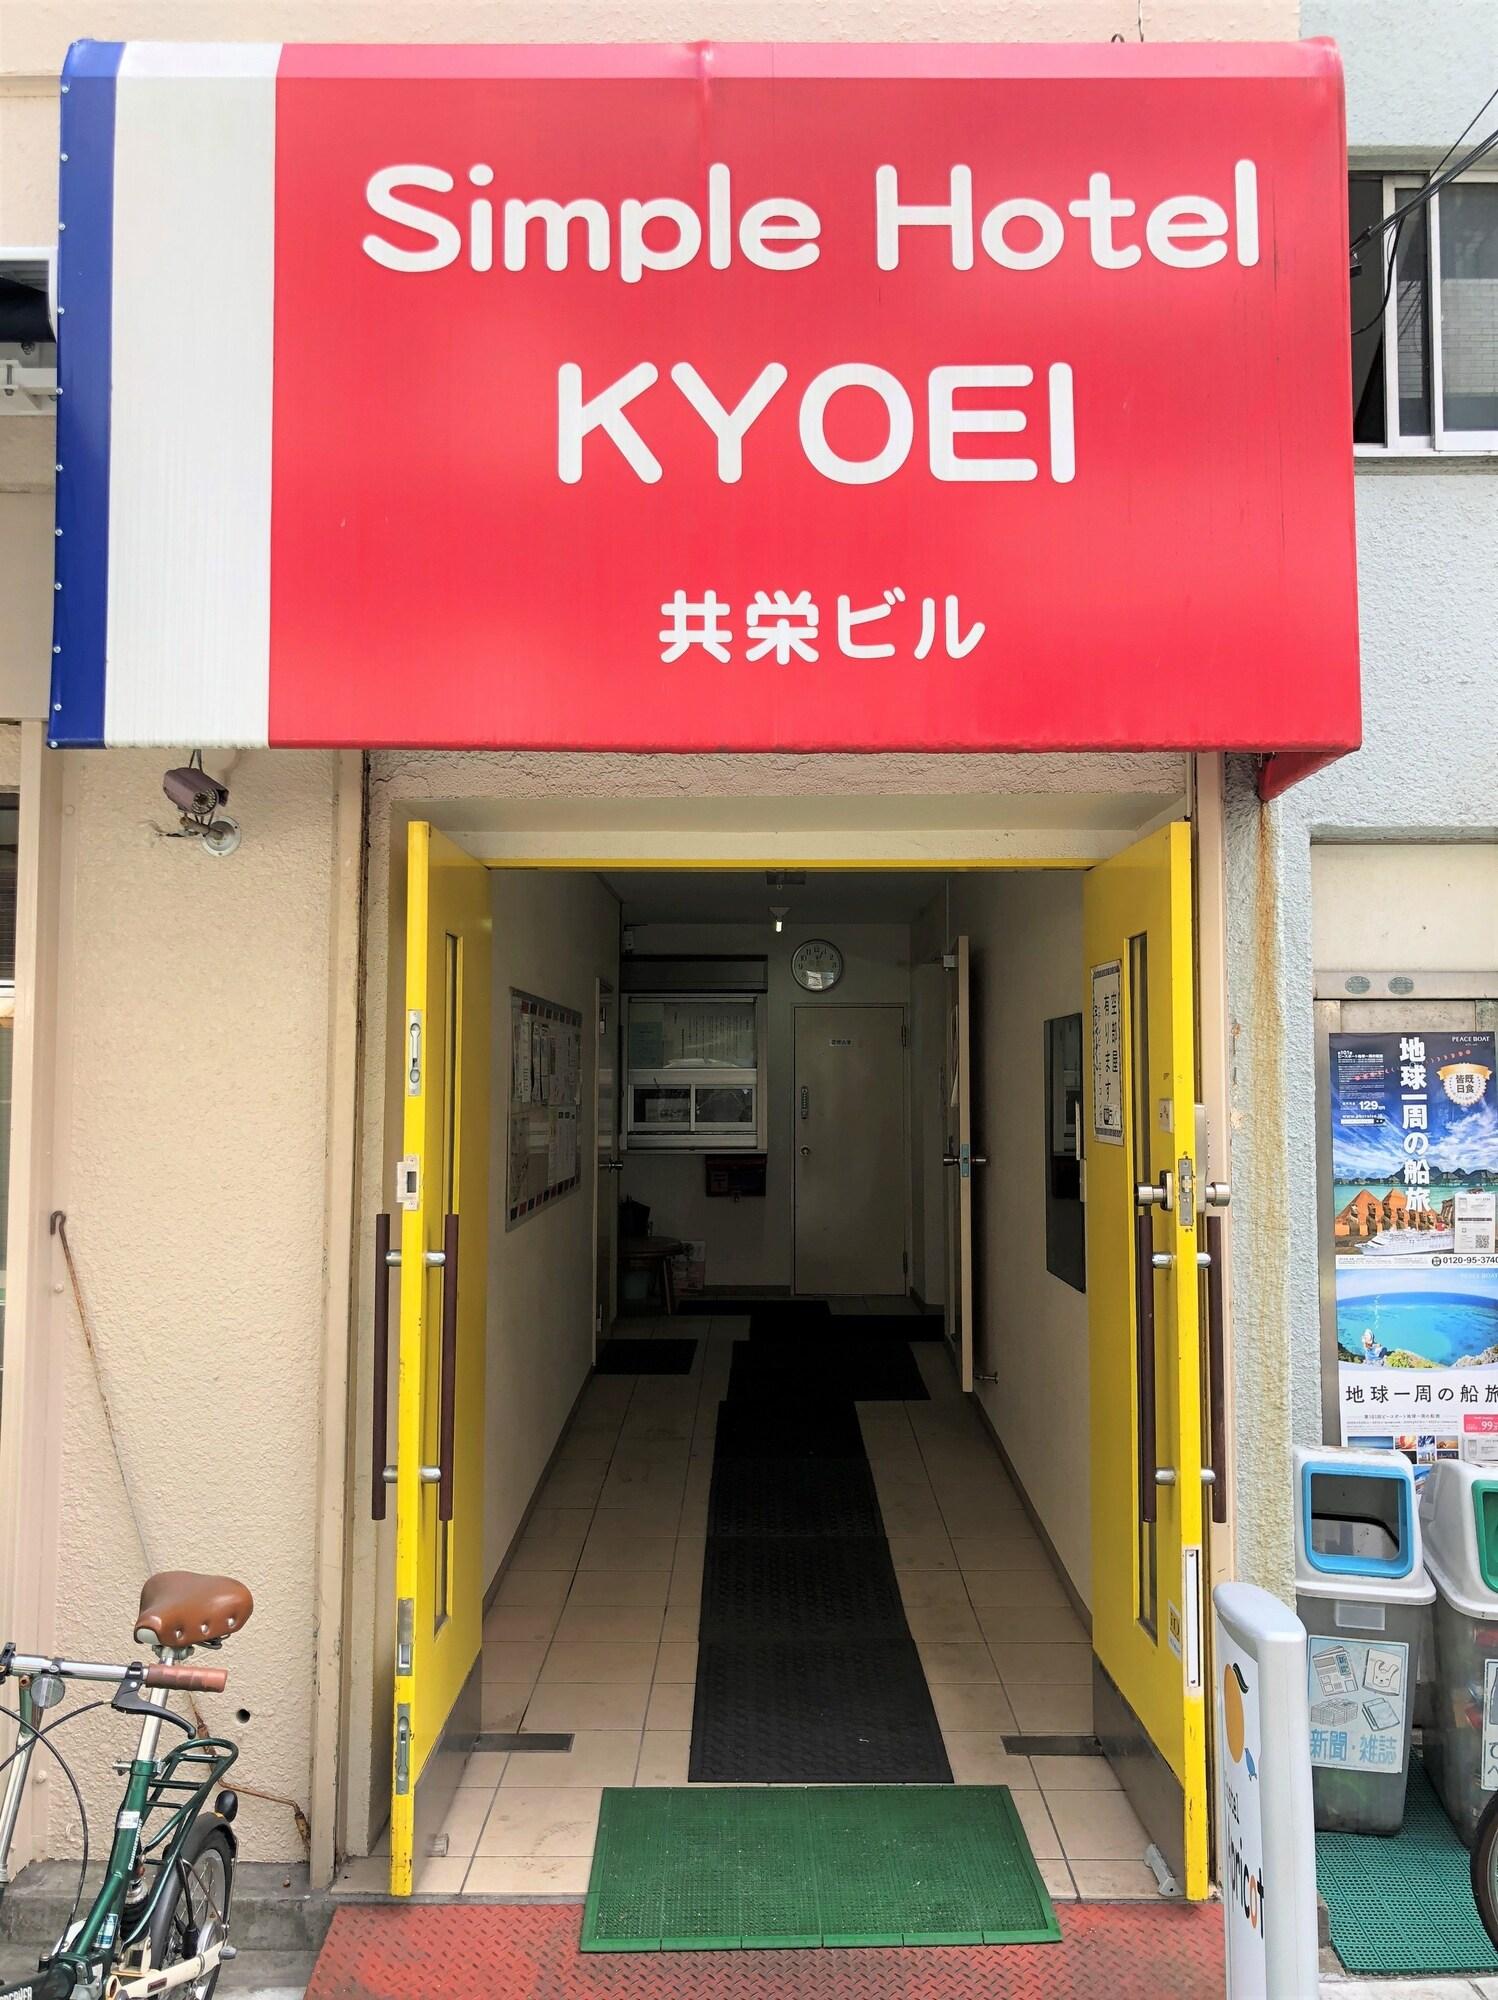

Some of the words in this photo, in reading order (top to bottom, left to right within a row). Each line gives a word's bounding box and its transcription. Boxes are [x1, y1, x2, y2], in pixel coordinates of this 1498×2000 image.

[362, 163, 822, 283] Simple
[875, 158, 1261, 271] Hotel
[557, 362, 1076, 485] KYOEI
[659, 586, 986, 666] 共栄ビル
[1399, 1036, 1431, 1212] 地球一周の船旅
[1456, 1084, 1475, 1094] 日食
[1345, 1384, 1498, 1404] 地球一周の船旅
